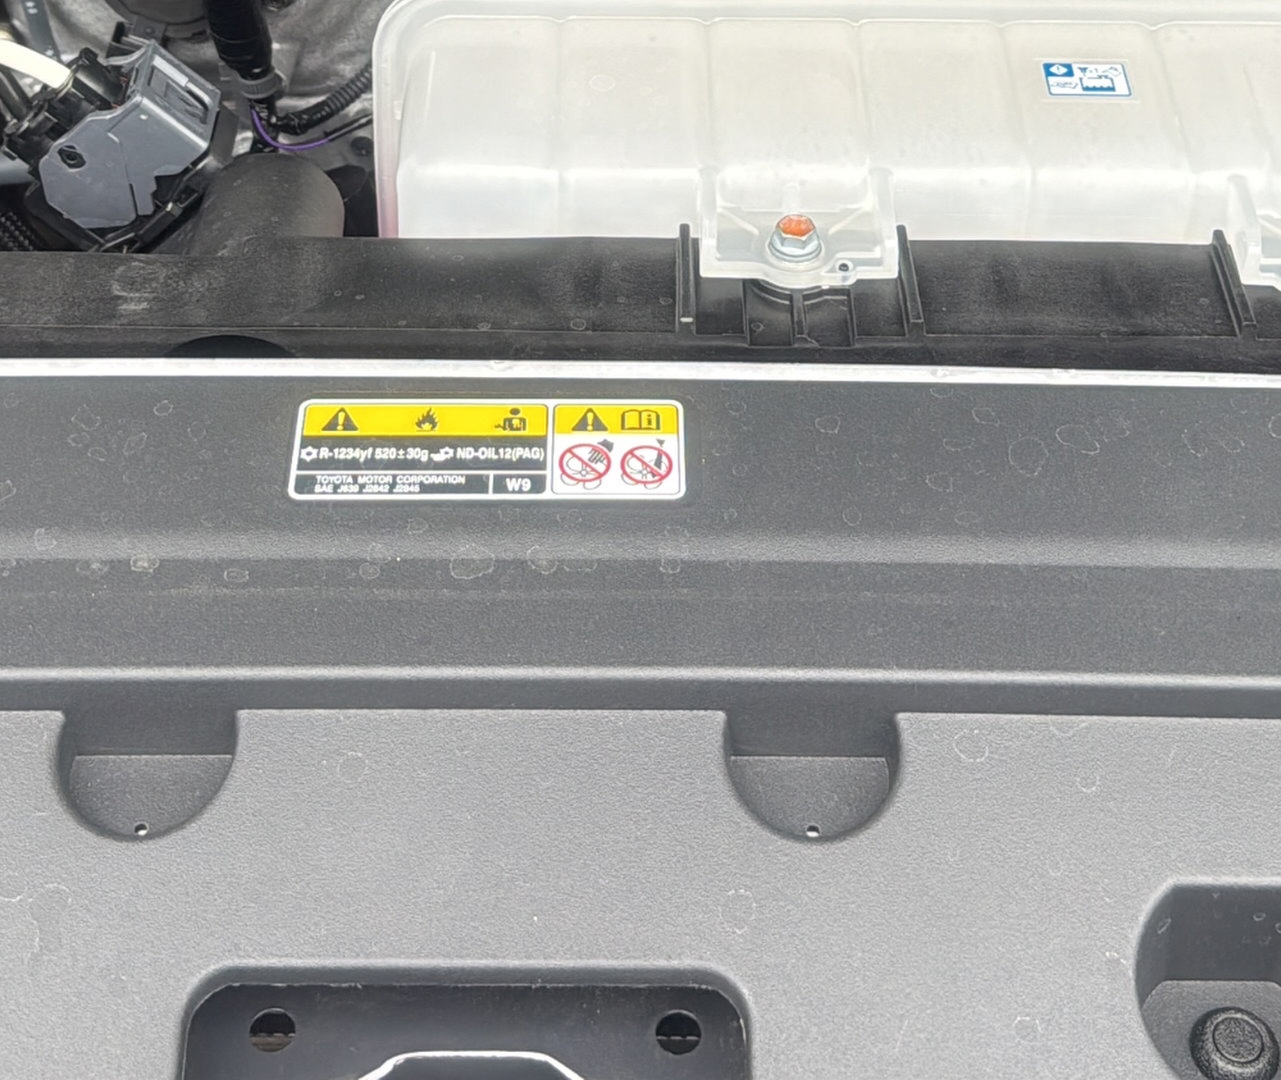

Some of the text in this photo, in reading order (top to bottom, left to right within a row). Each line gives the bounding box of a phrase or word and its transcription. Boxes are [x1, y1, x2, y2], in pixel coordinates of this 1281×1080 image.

[319, 447, 372, 463] R-1234yf
[456, 447, 544, 462] ND-OIL12(PAG)
[315, 475, 466, 484] TOYOTA MOTOR CORPORATION
[506, 478, 531, 492] W9
[314, 484, 335, 494] SAE
